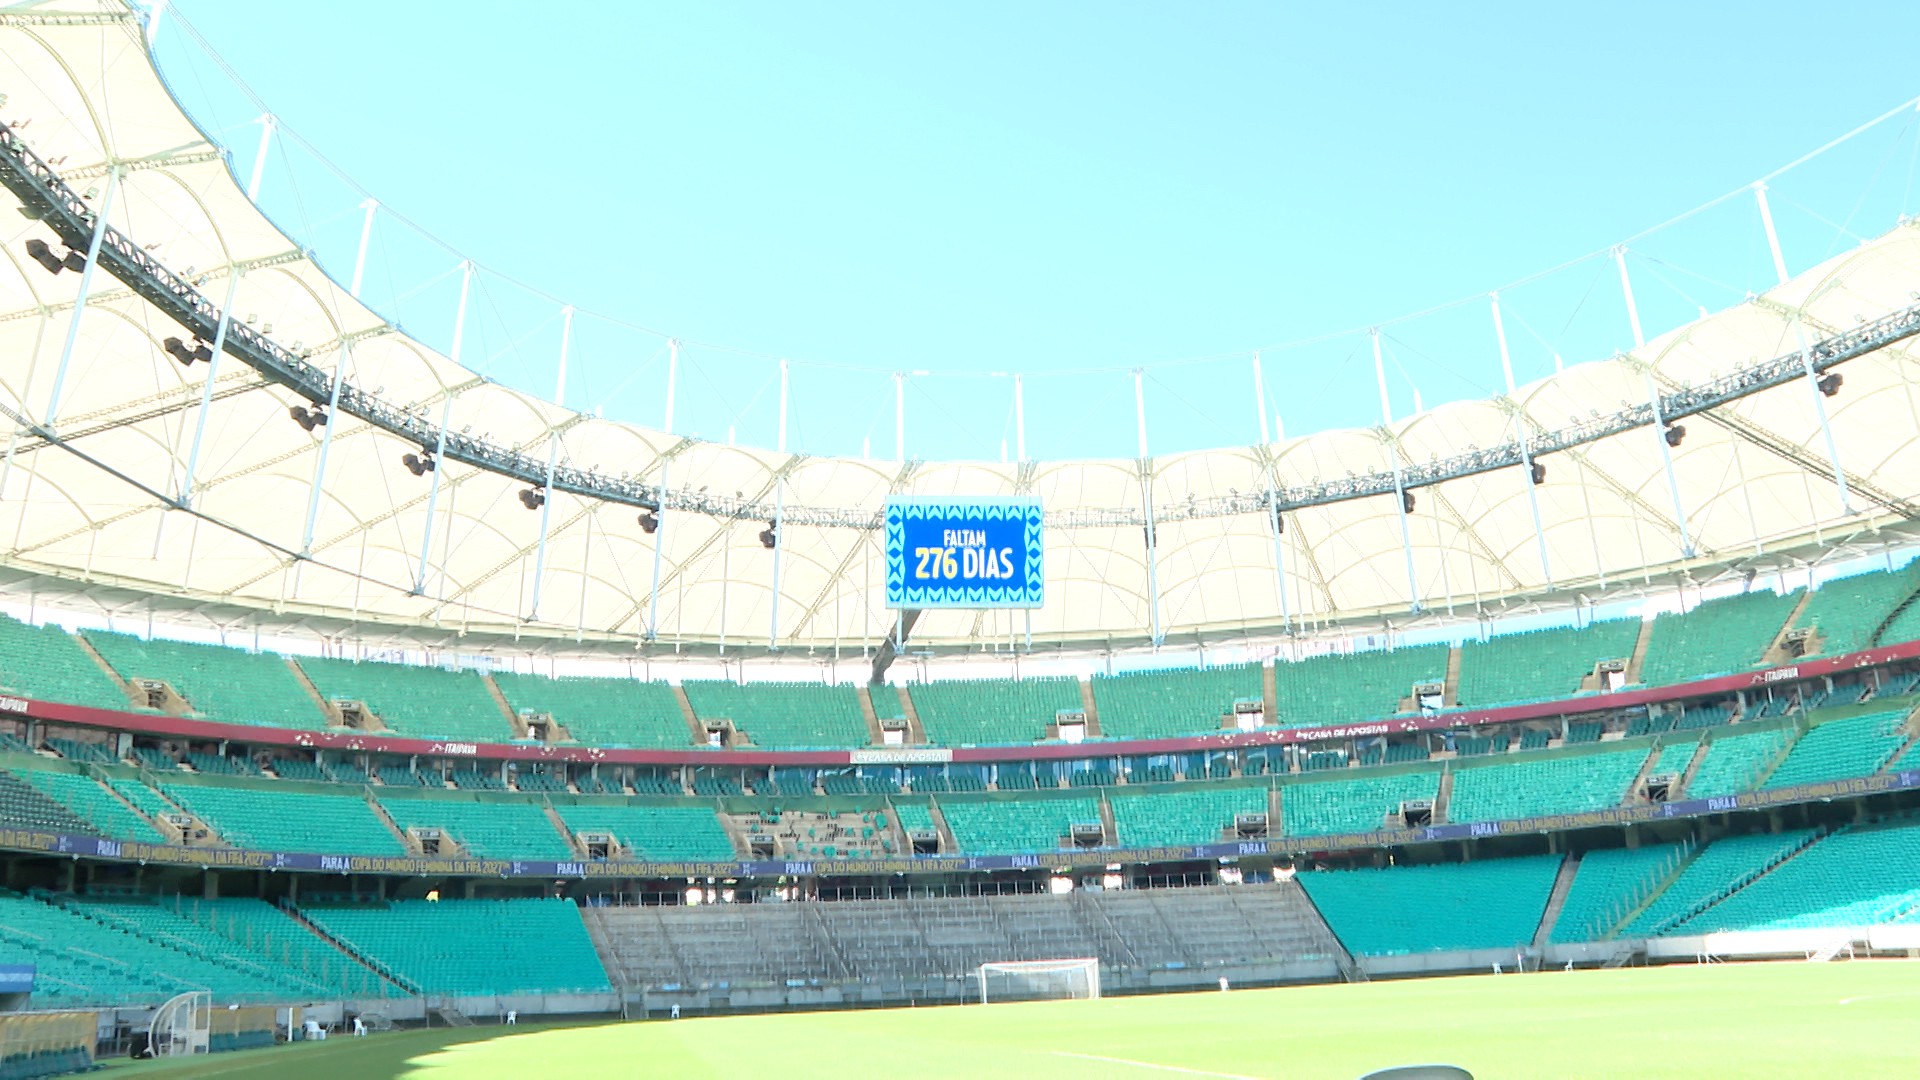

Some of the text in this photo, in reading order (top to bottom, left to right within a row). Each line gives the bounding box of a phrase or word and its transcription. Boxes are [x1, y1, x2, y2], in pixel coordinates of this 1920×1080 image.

[944, 529, 986, 546] FALTAM
[916, 547, 1014, 579] 276 DIAS
[1308, 724, 1389, 740] CASA DE APOSTAS
[322, 856, 341, 869] PARA
[343, 858, 350, 870] A
[556, 863, 578, 874] PARA
[579, 864, 584, 874] A
[606, 864, 617, 874] DO
[696, 864, 711, 874] FIFA
[786, 863, 804, 874] PARA
[805, 863, 812, 874] A
